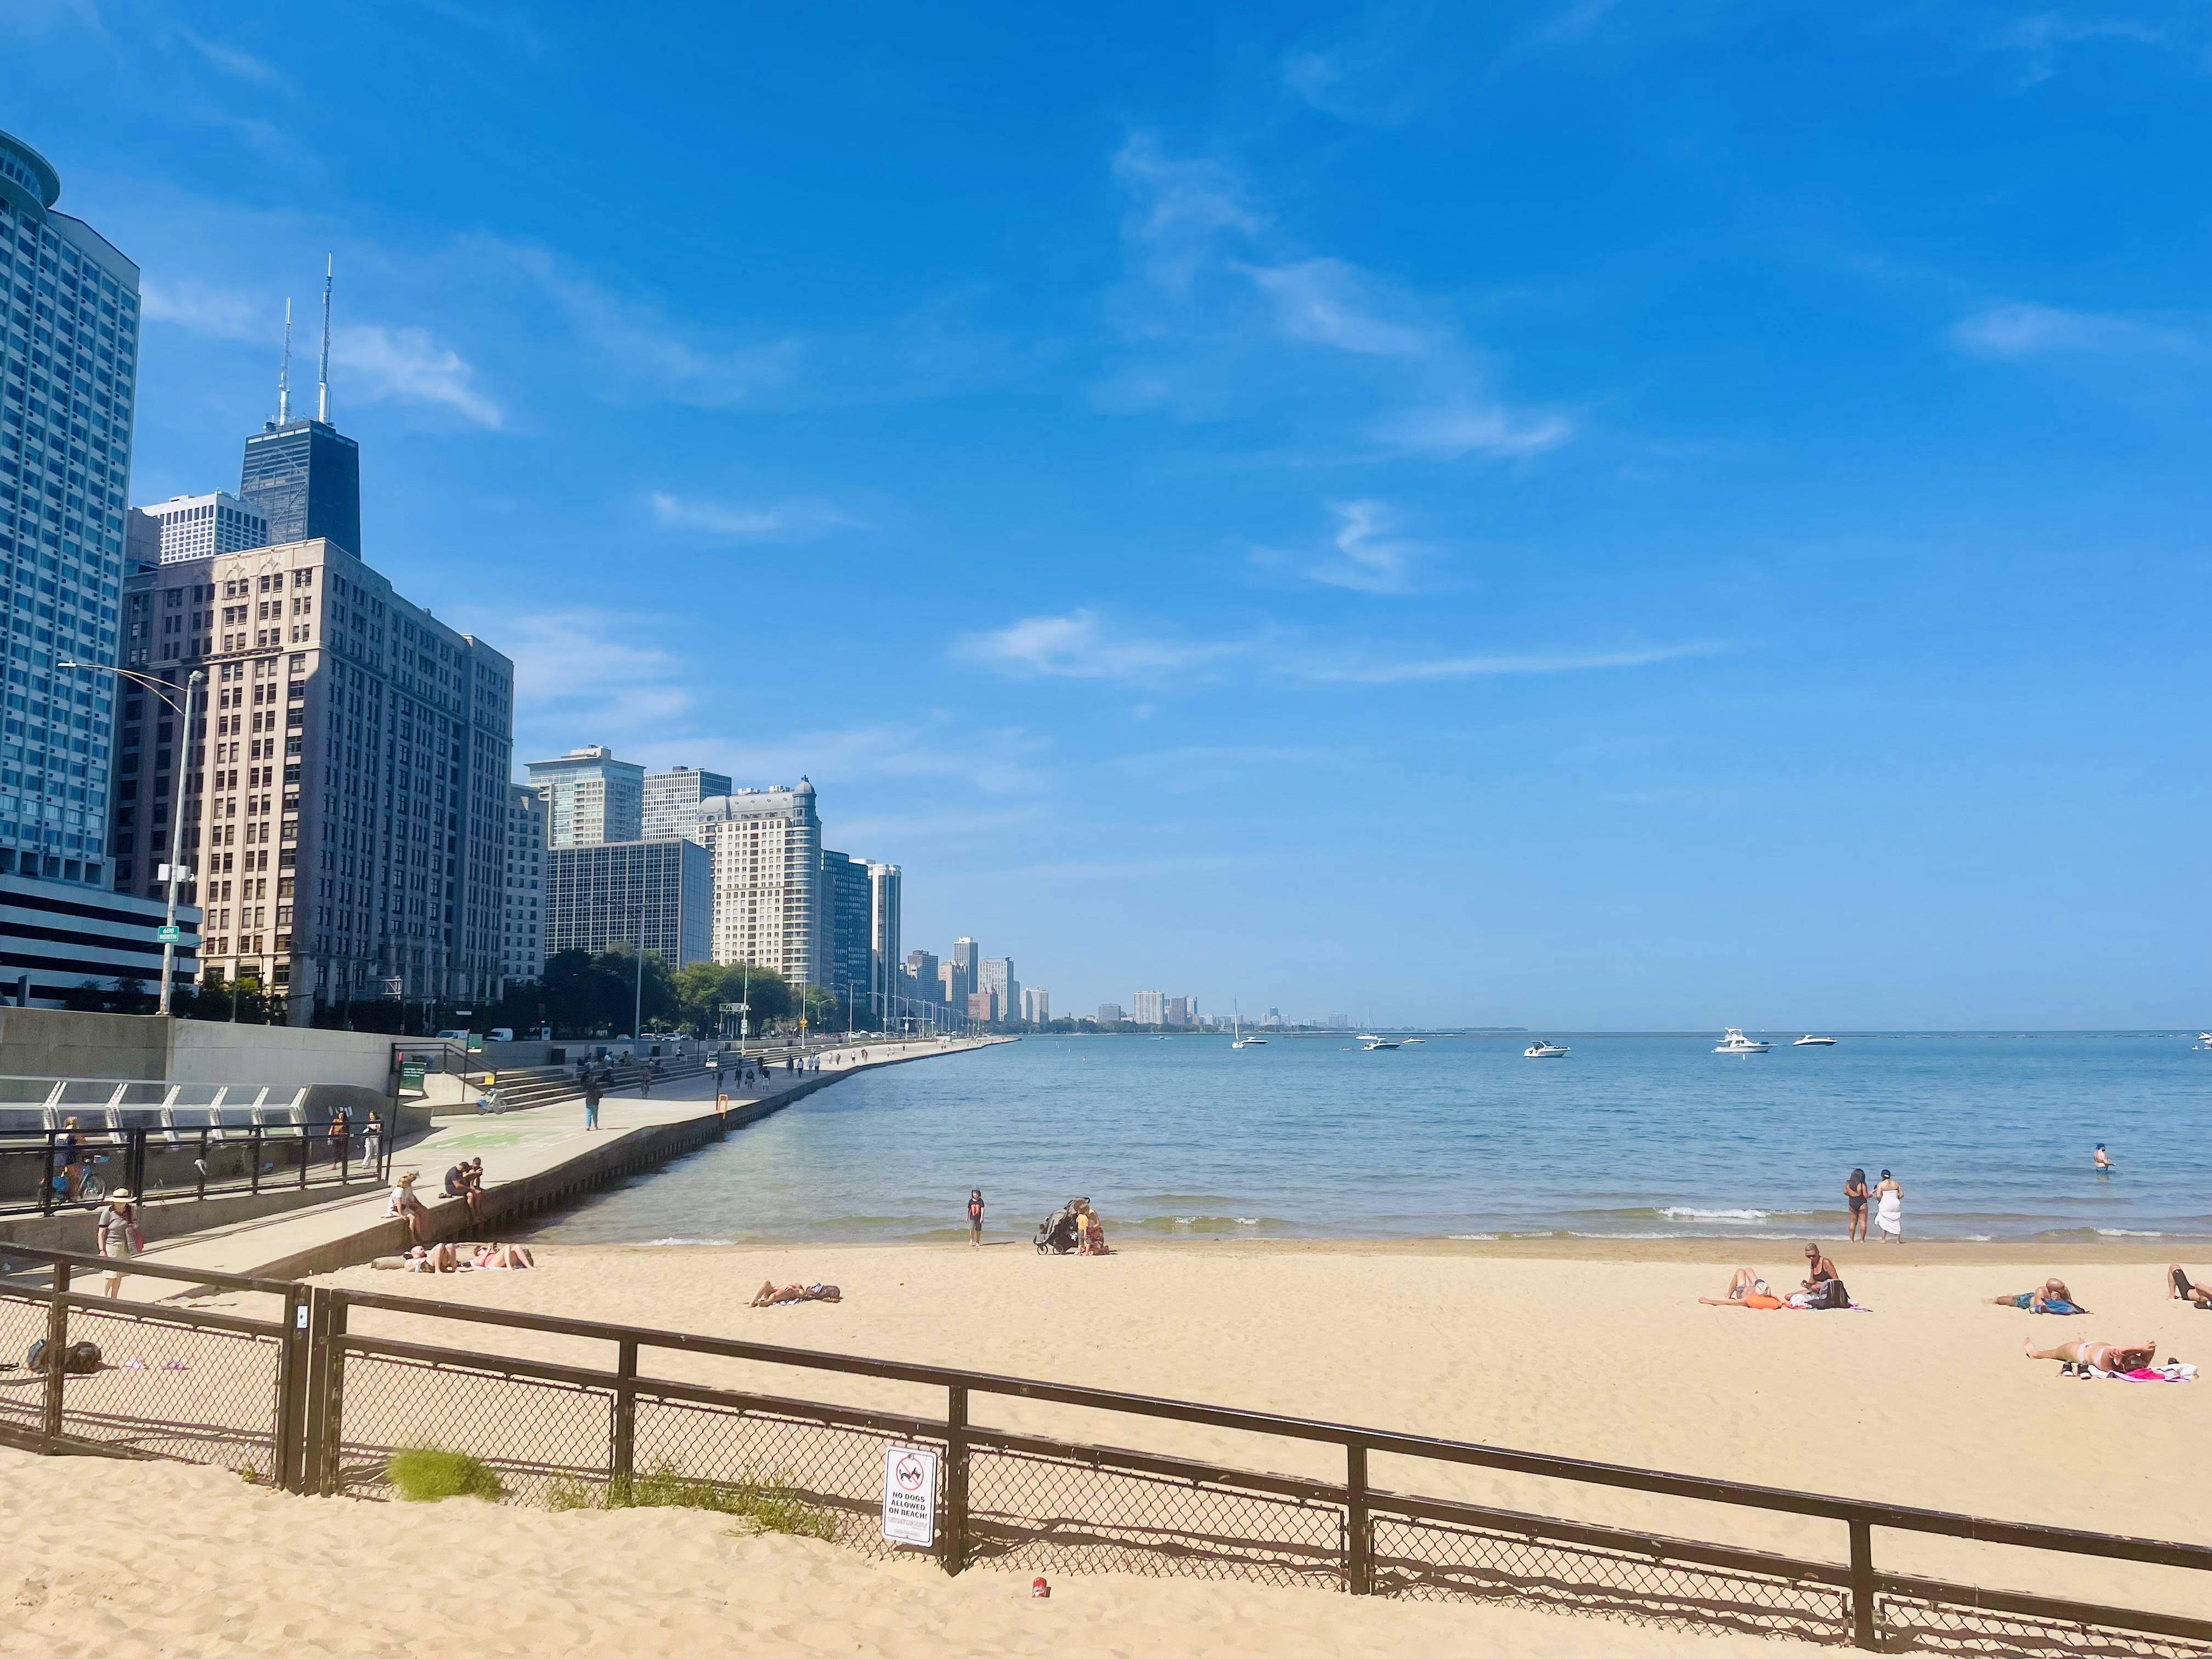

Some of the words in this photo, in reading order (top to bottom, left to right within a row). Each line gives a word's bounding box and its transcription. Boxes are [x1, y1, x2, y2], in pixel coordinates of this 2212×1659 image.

[905, 1493, 925, 1503] DOGS
[891, 1499, 926, 1511] ALLOWED
[901, 1509, 927, 1519] BEACH!
